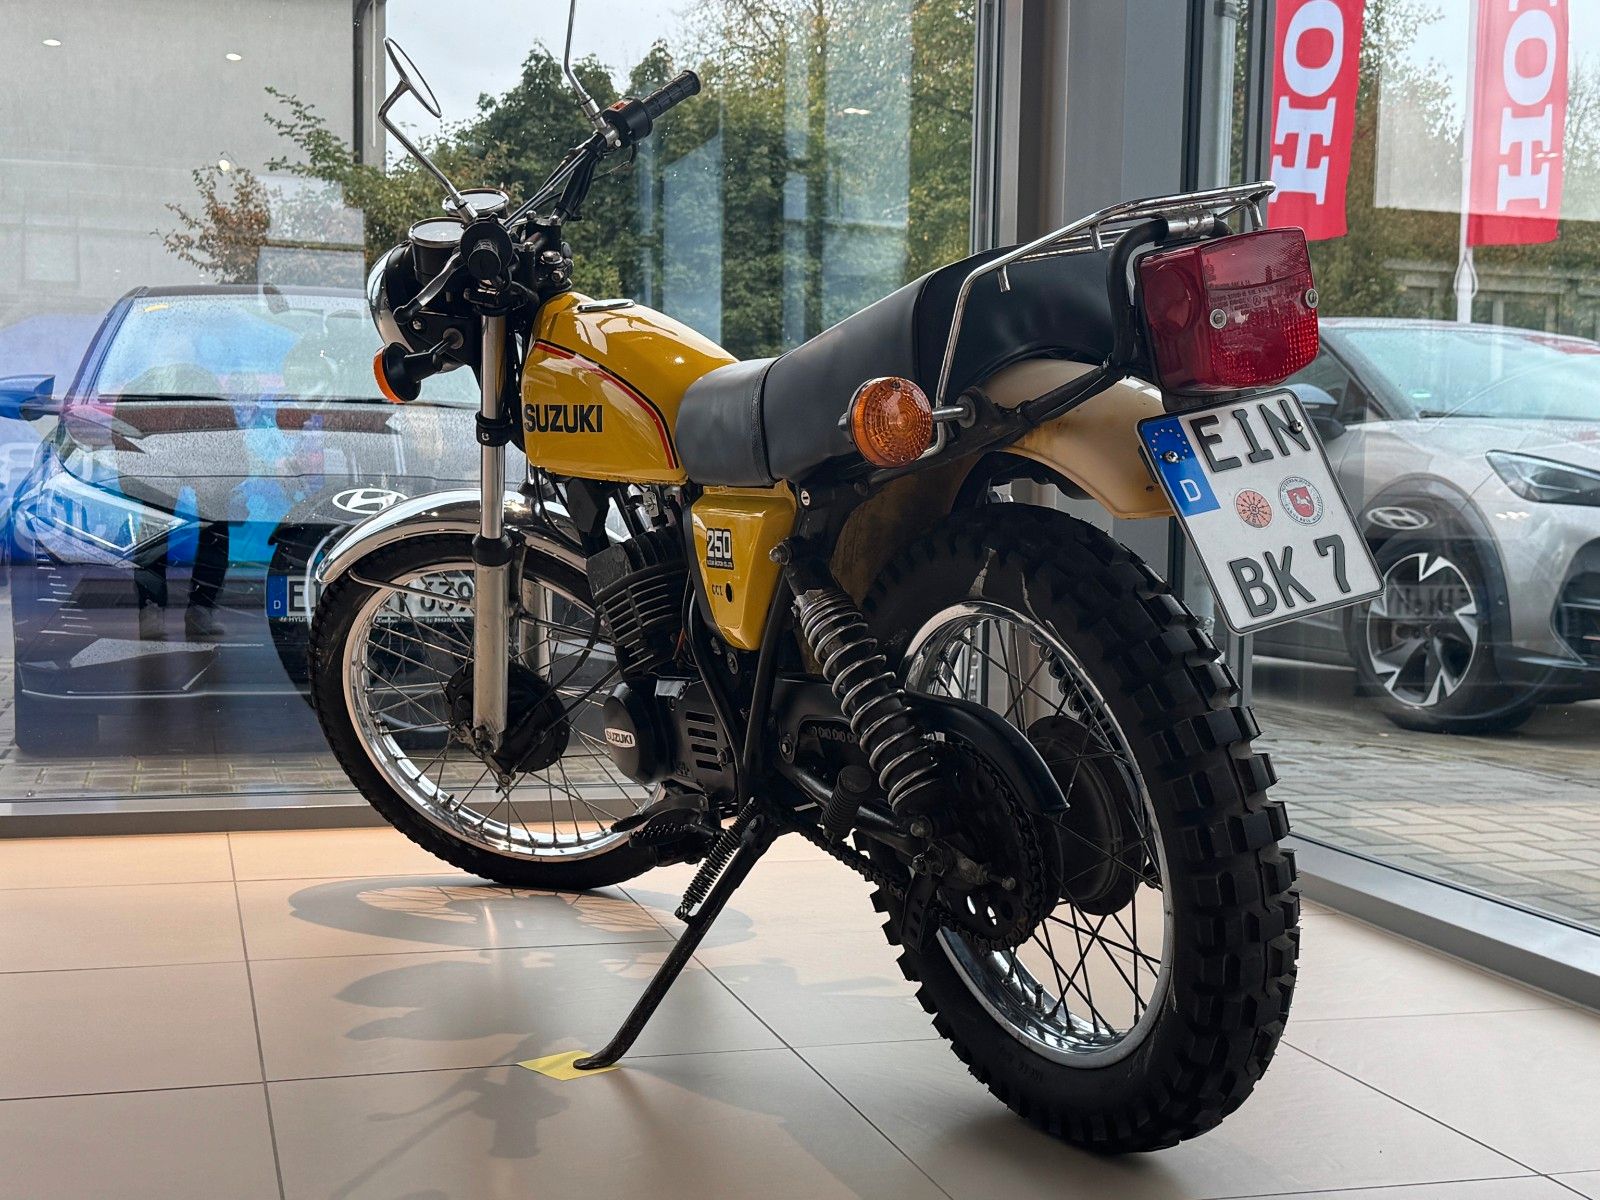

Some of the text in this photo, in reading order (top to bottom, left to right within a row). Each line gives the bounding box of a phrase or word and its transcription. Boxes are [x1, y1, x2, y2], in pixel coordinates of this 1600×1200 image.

[1496, 0, 1557, 212] HO
[523, 403, 604, 434] SUZUKI
[1188, 399, 1312, 473] EIN
[1179, 478, 1202, 502] D
[706, 529, 732, 559] 250
[1228, 545, 1317, 619] BK
[1313, 533, 1352, 594] 7
[273, 599, 282, 610] D
[605, 730, 634, 745] SUZUKI
